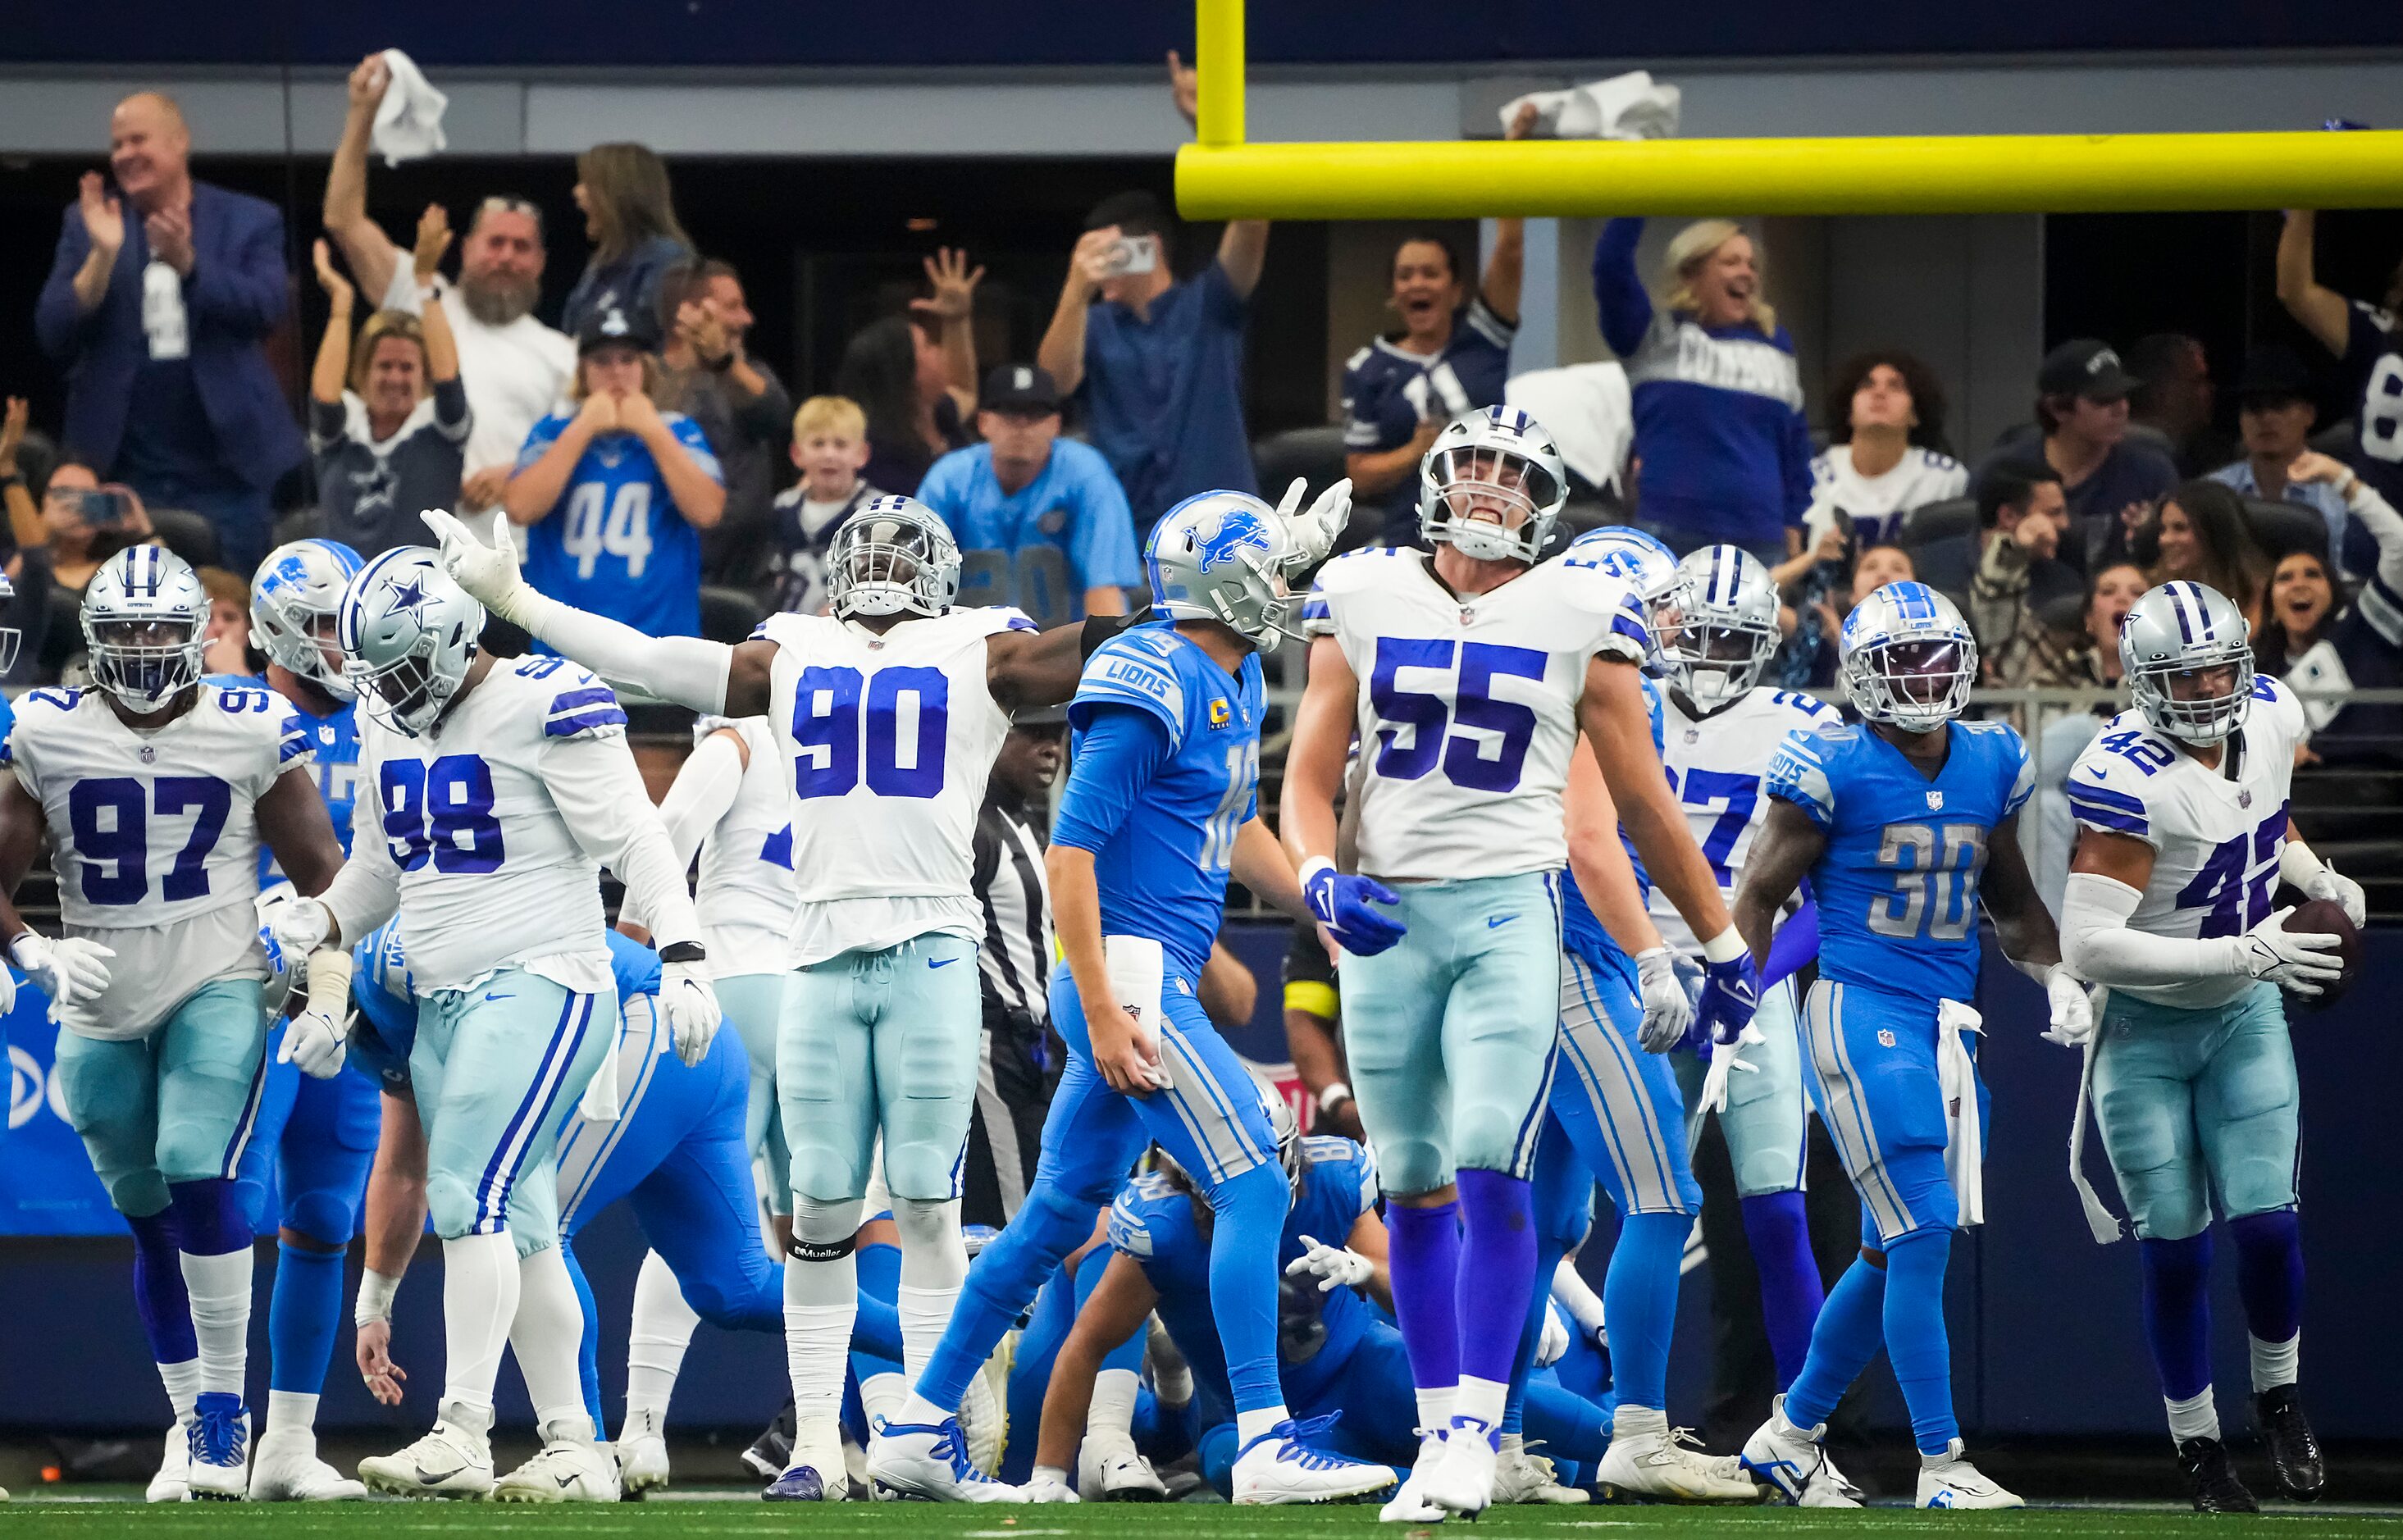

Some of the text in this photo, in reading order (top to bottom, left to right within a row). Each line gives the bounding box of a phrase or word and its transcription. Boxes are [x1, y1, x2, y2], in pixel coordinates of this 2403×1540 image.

[562, 481, 654, 580] 44
[791, 666, 948, 800] 90
[1106, 660, 1171, 699] LIONS
[1210, 699, 1229, 725] C
[1370, 636, 1548, 793] 55
[1199, 740, 1260, 871] 16
[2100, 730, 2177, 777] 42
[69, 776, 232, 905] 97
[379, 754, 506, 875] 98
[1665, 764, 1762, 887] 7
[2174, 799, 2291, 938] 42
[1867, 822, 1986, 941] 30
[802, 1246, 841, 1258] Mueller
